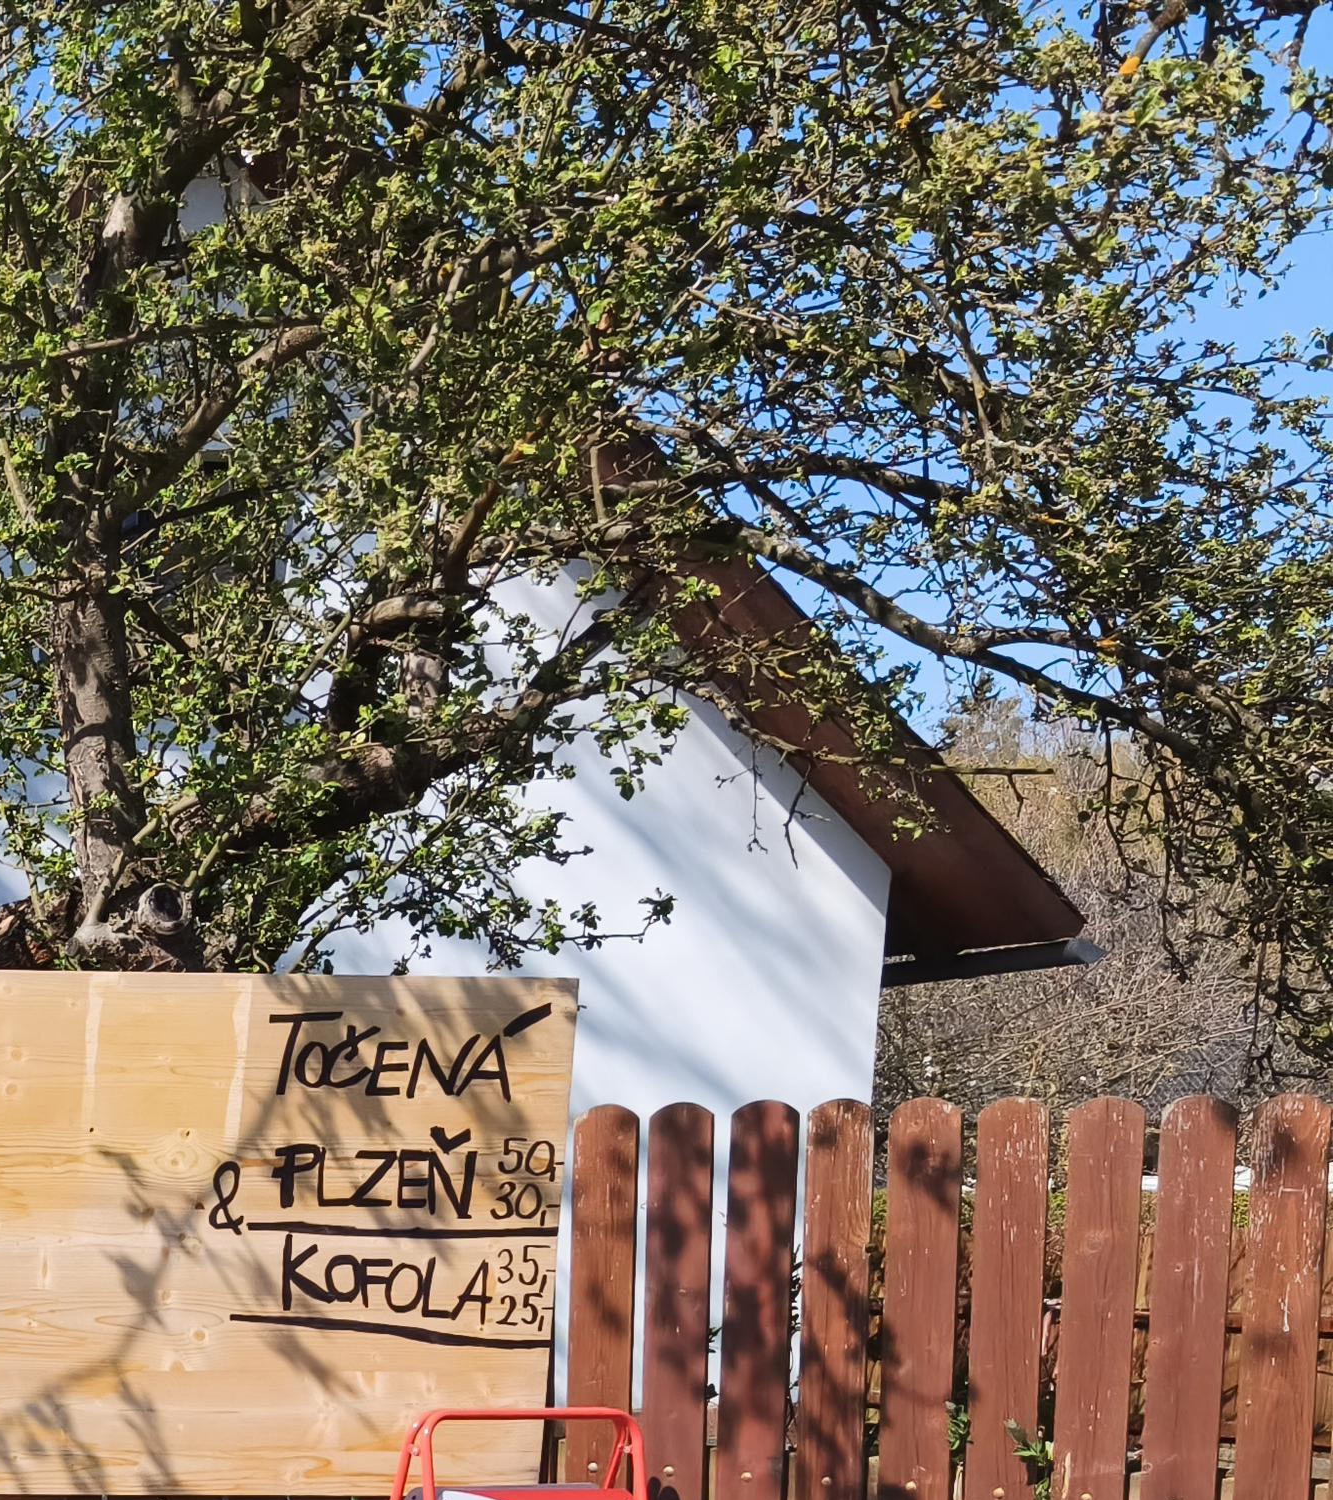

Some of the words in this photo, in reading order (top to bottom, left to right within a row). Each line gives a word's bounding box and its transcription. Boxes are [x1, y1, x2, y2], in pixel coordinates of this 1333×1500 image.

[269, 1002, 552, 1103] TOČENÁ
[208, 1160, 244, 1235] &
[271, 1126, 479, 1220] PLZEŇ
[282, 1234, 493, 1326] KOFOLA
